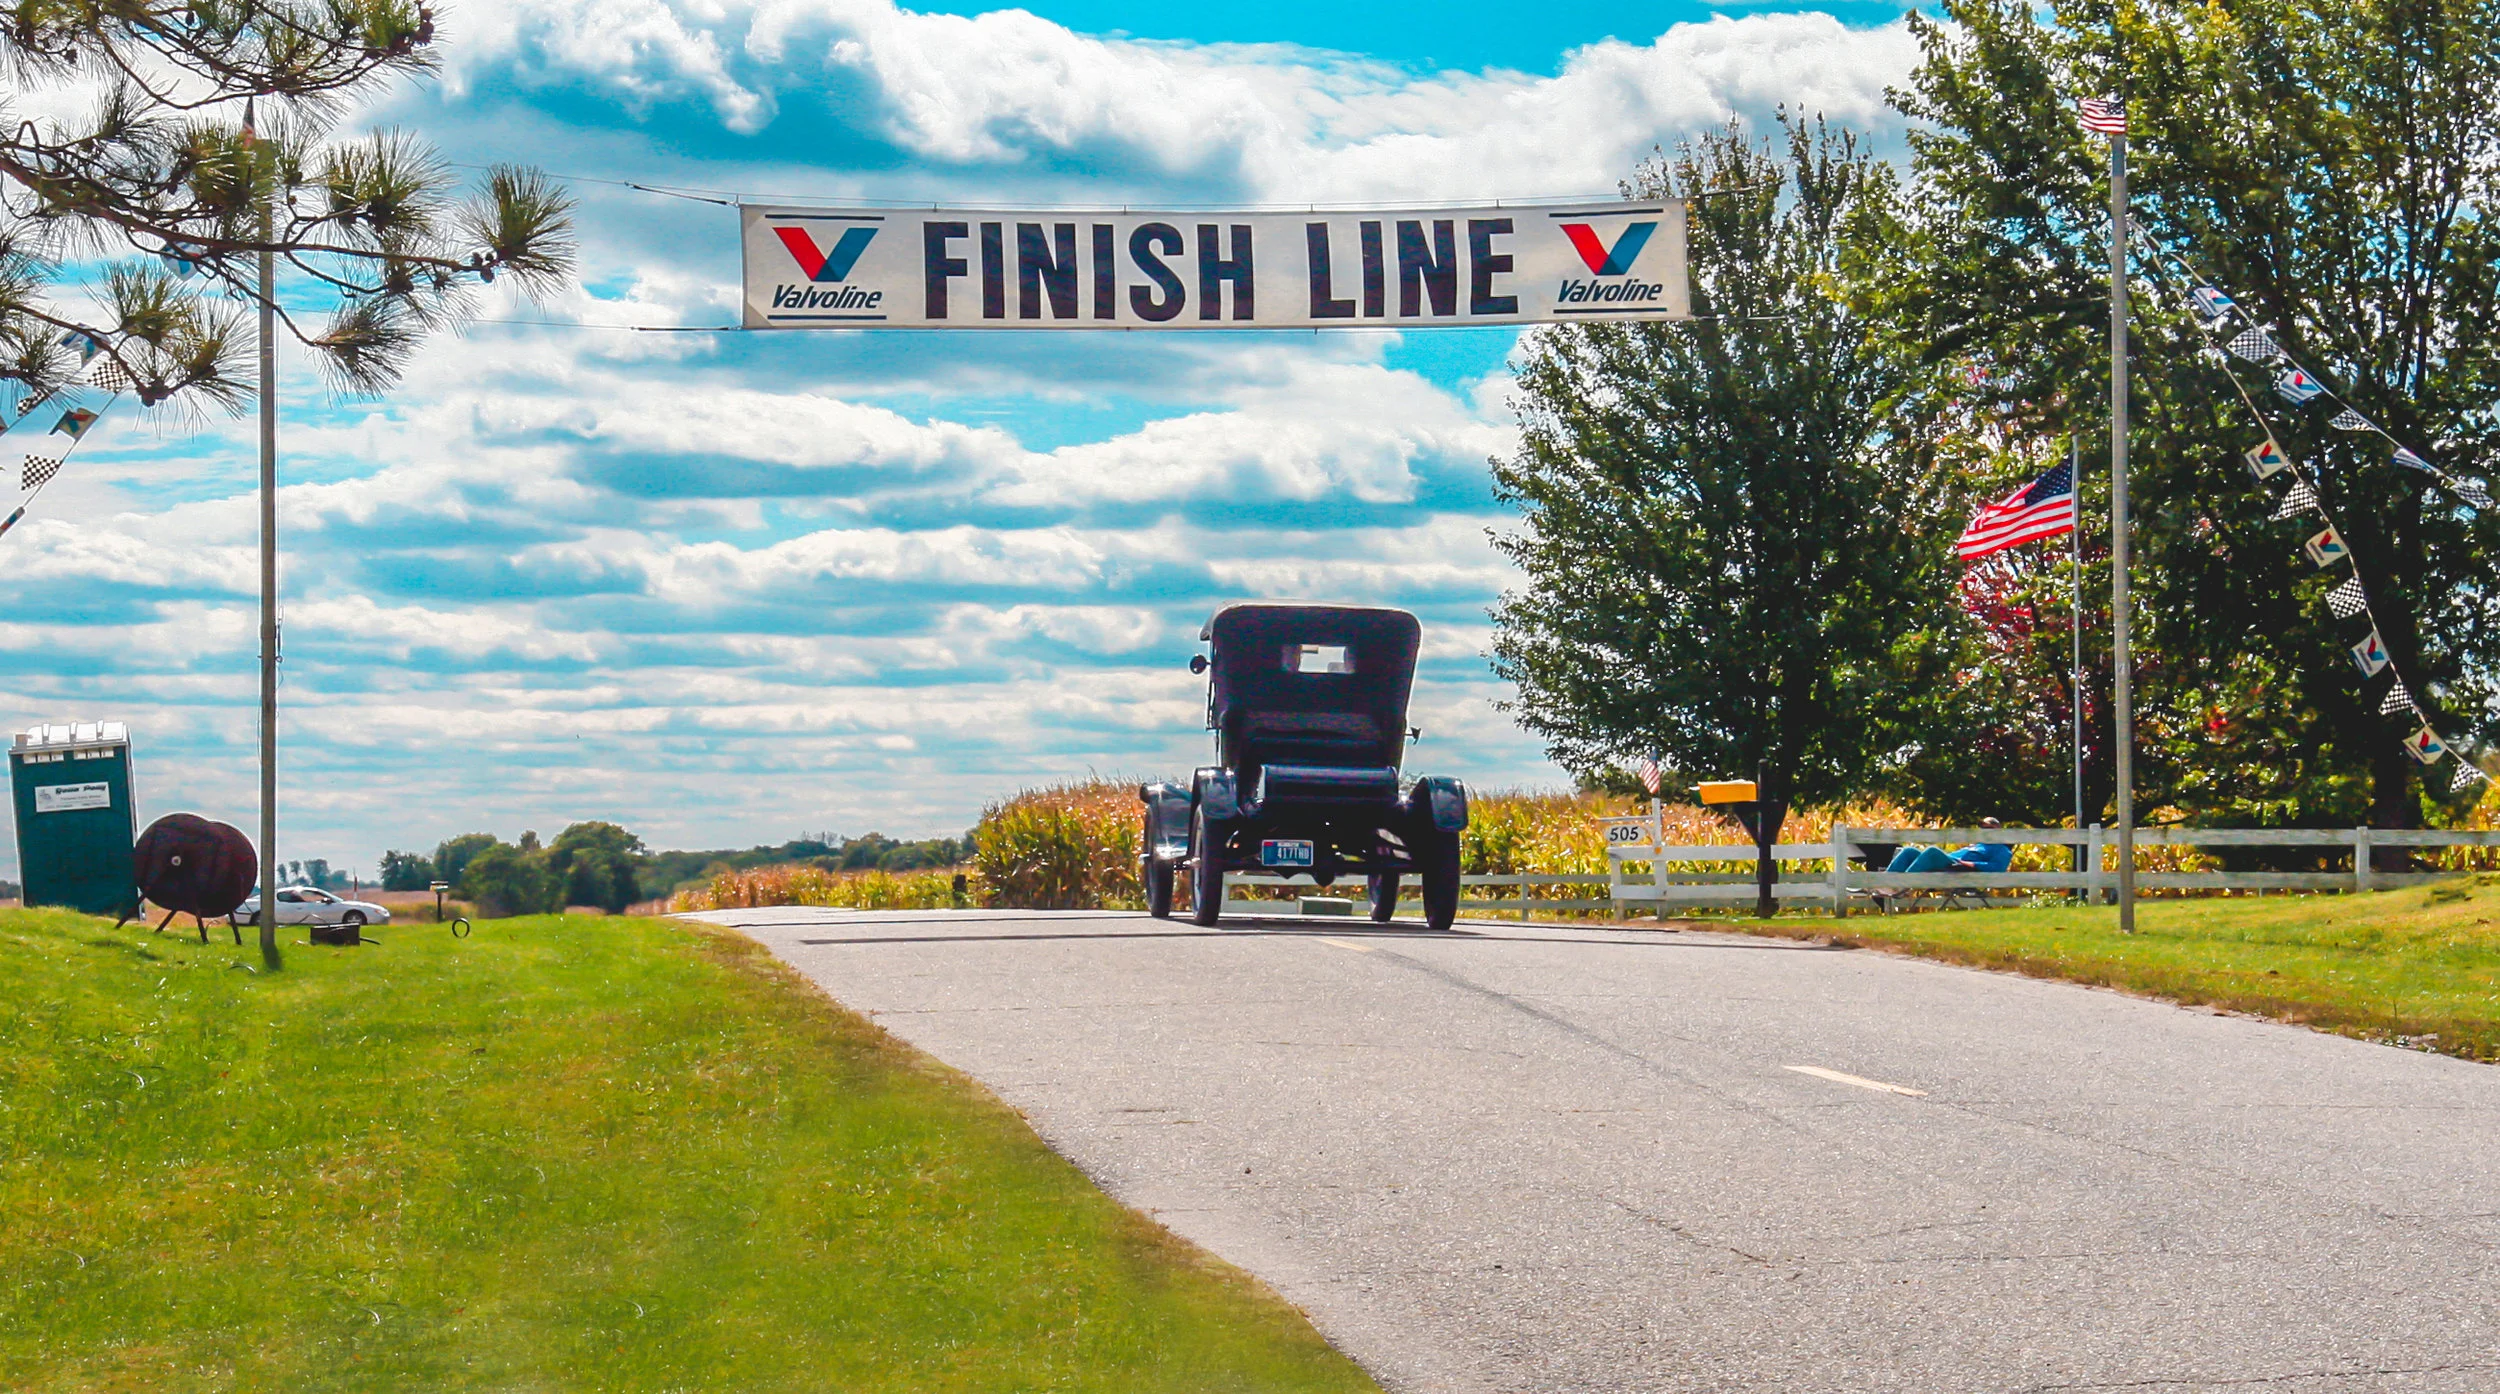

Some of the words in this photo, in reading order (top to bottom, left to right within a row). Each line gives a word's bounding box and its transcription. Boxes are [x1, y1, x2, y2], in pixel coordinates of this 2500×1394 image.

[923, 221, 1254, 322] FINISH
[1306, 218, 1519, 319] LINE
[771, 284, 883, 310] Valvoline
[1557, 278, 1663, 304] Valvoline
[1610, 826, 1639, 841] 505
